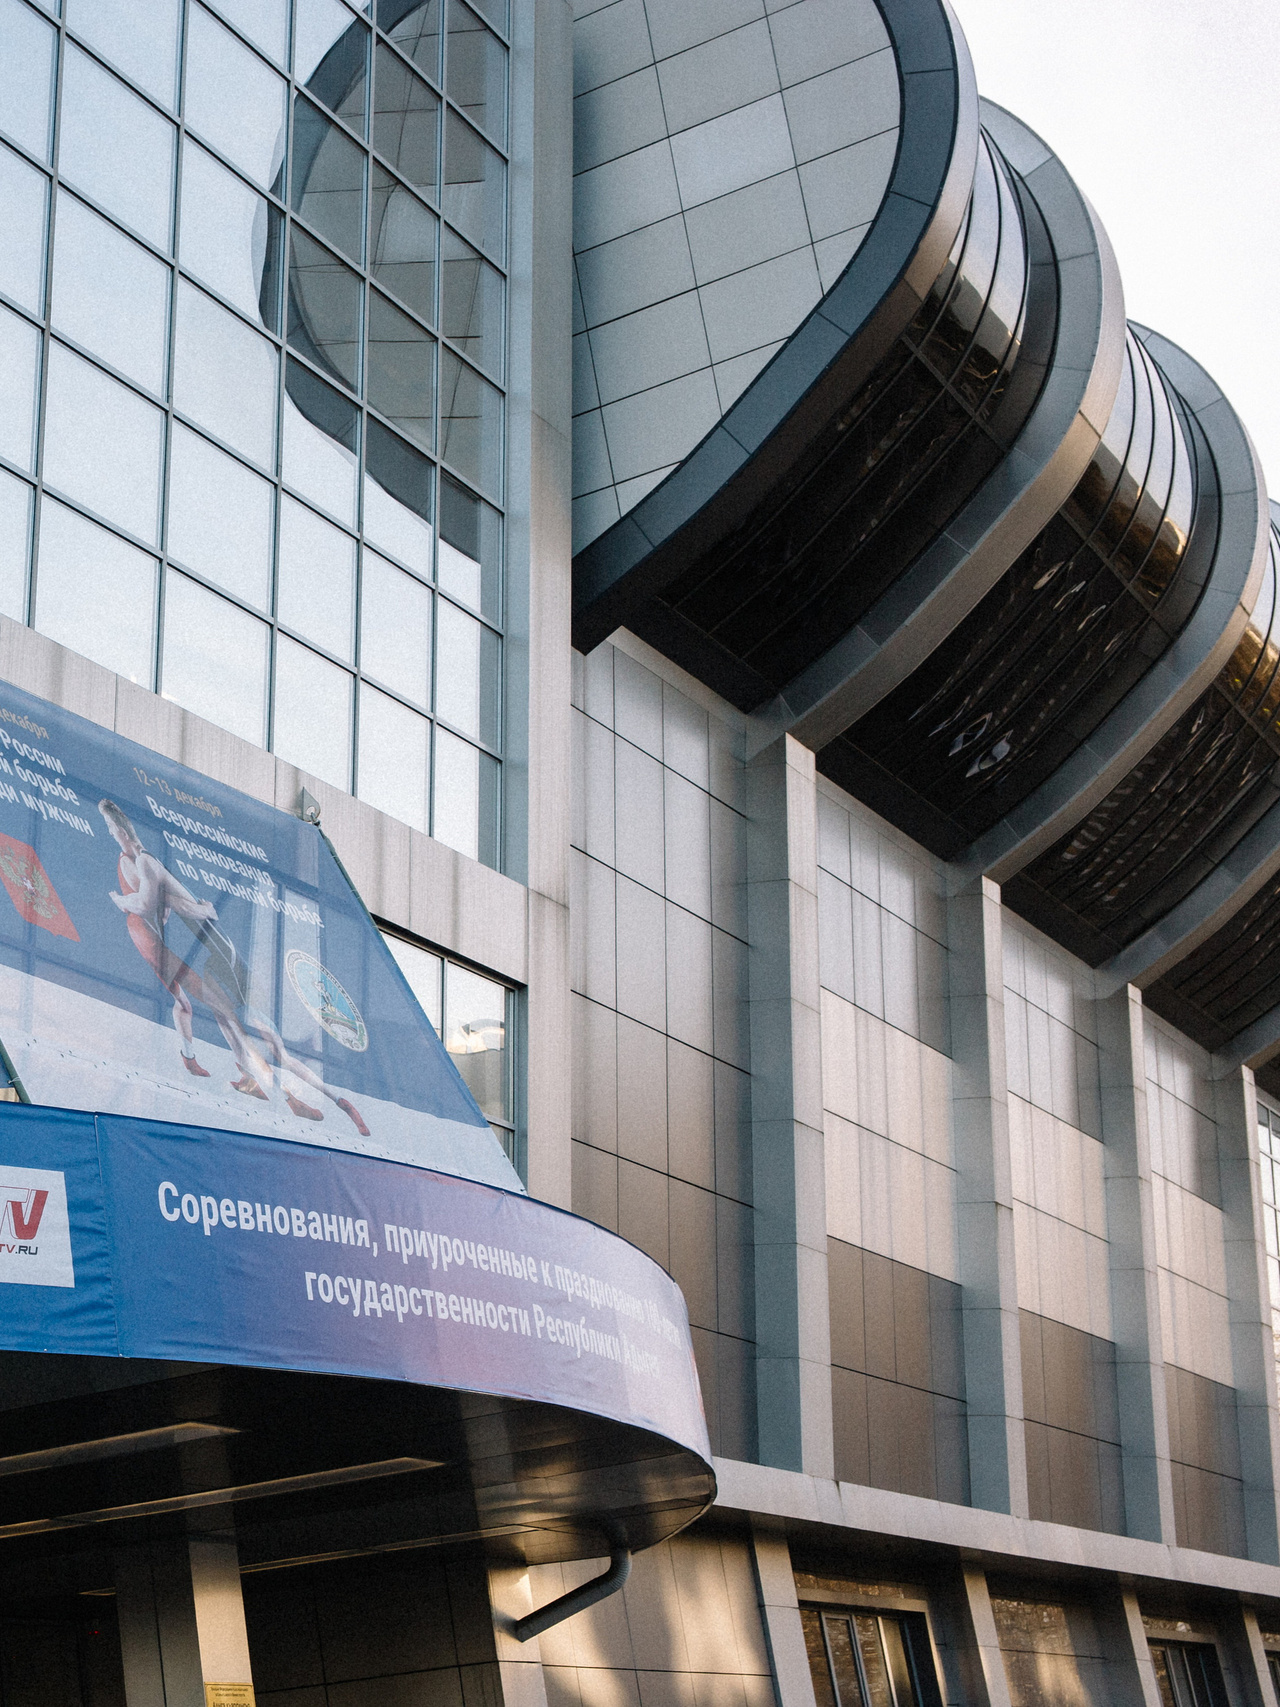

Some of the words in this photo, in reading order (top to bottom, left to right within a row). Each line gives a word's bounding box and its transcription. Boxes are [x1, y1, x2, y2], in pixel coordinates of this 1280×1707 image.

[13, 758, 80, 806] борьбе
[20, 790, 95, 837] мужчин
[173, 788, 223, 818] декабря
[146, 795, 269, 863] Всероссийские
[162, 830, 276, 888] соревнования
[176, 859, 200, 881] по
[199, 868, 269, 908] вольной
[268, 892, 325, 928] борьбе
[157, 1181, 379, 1258] Соревнования,
[384, 1222, 538, 1284] приуроченные
[540, 1259, 554, 1288] к
[304, 1271, 532, 1337] государственности
[532, 1303, 623, 1363] Республики
